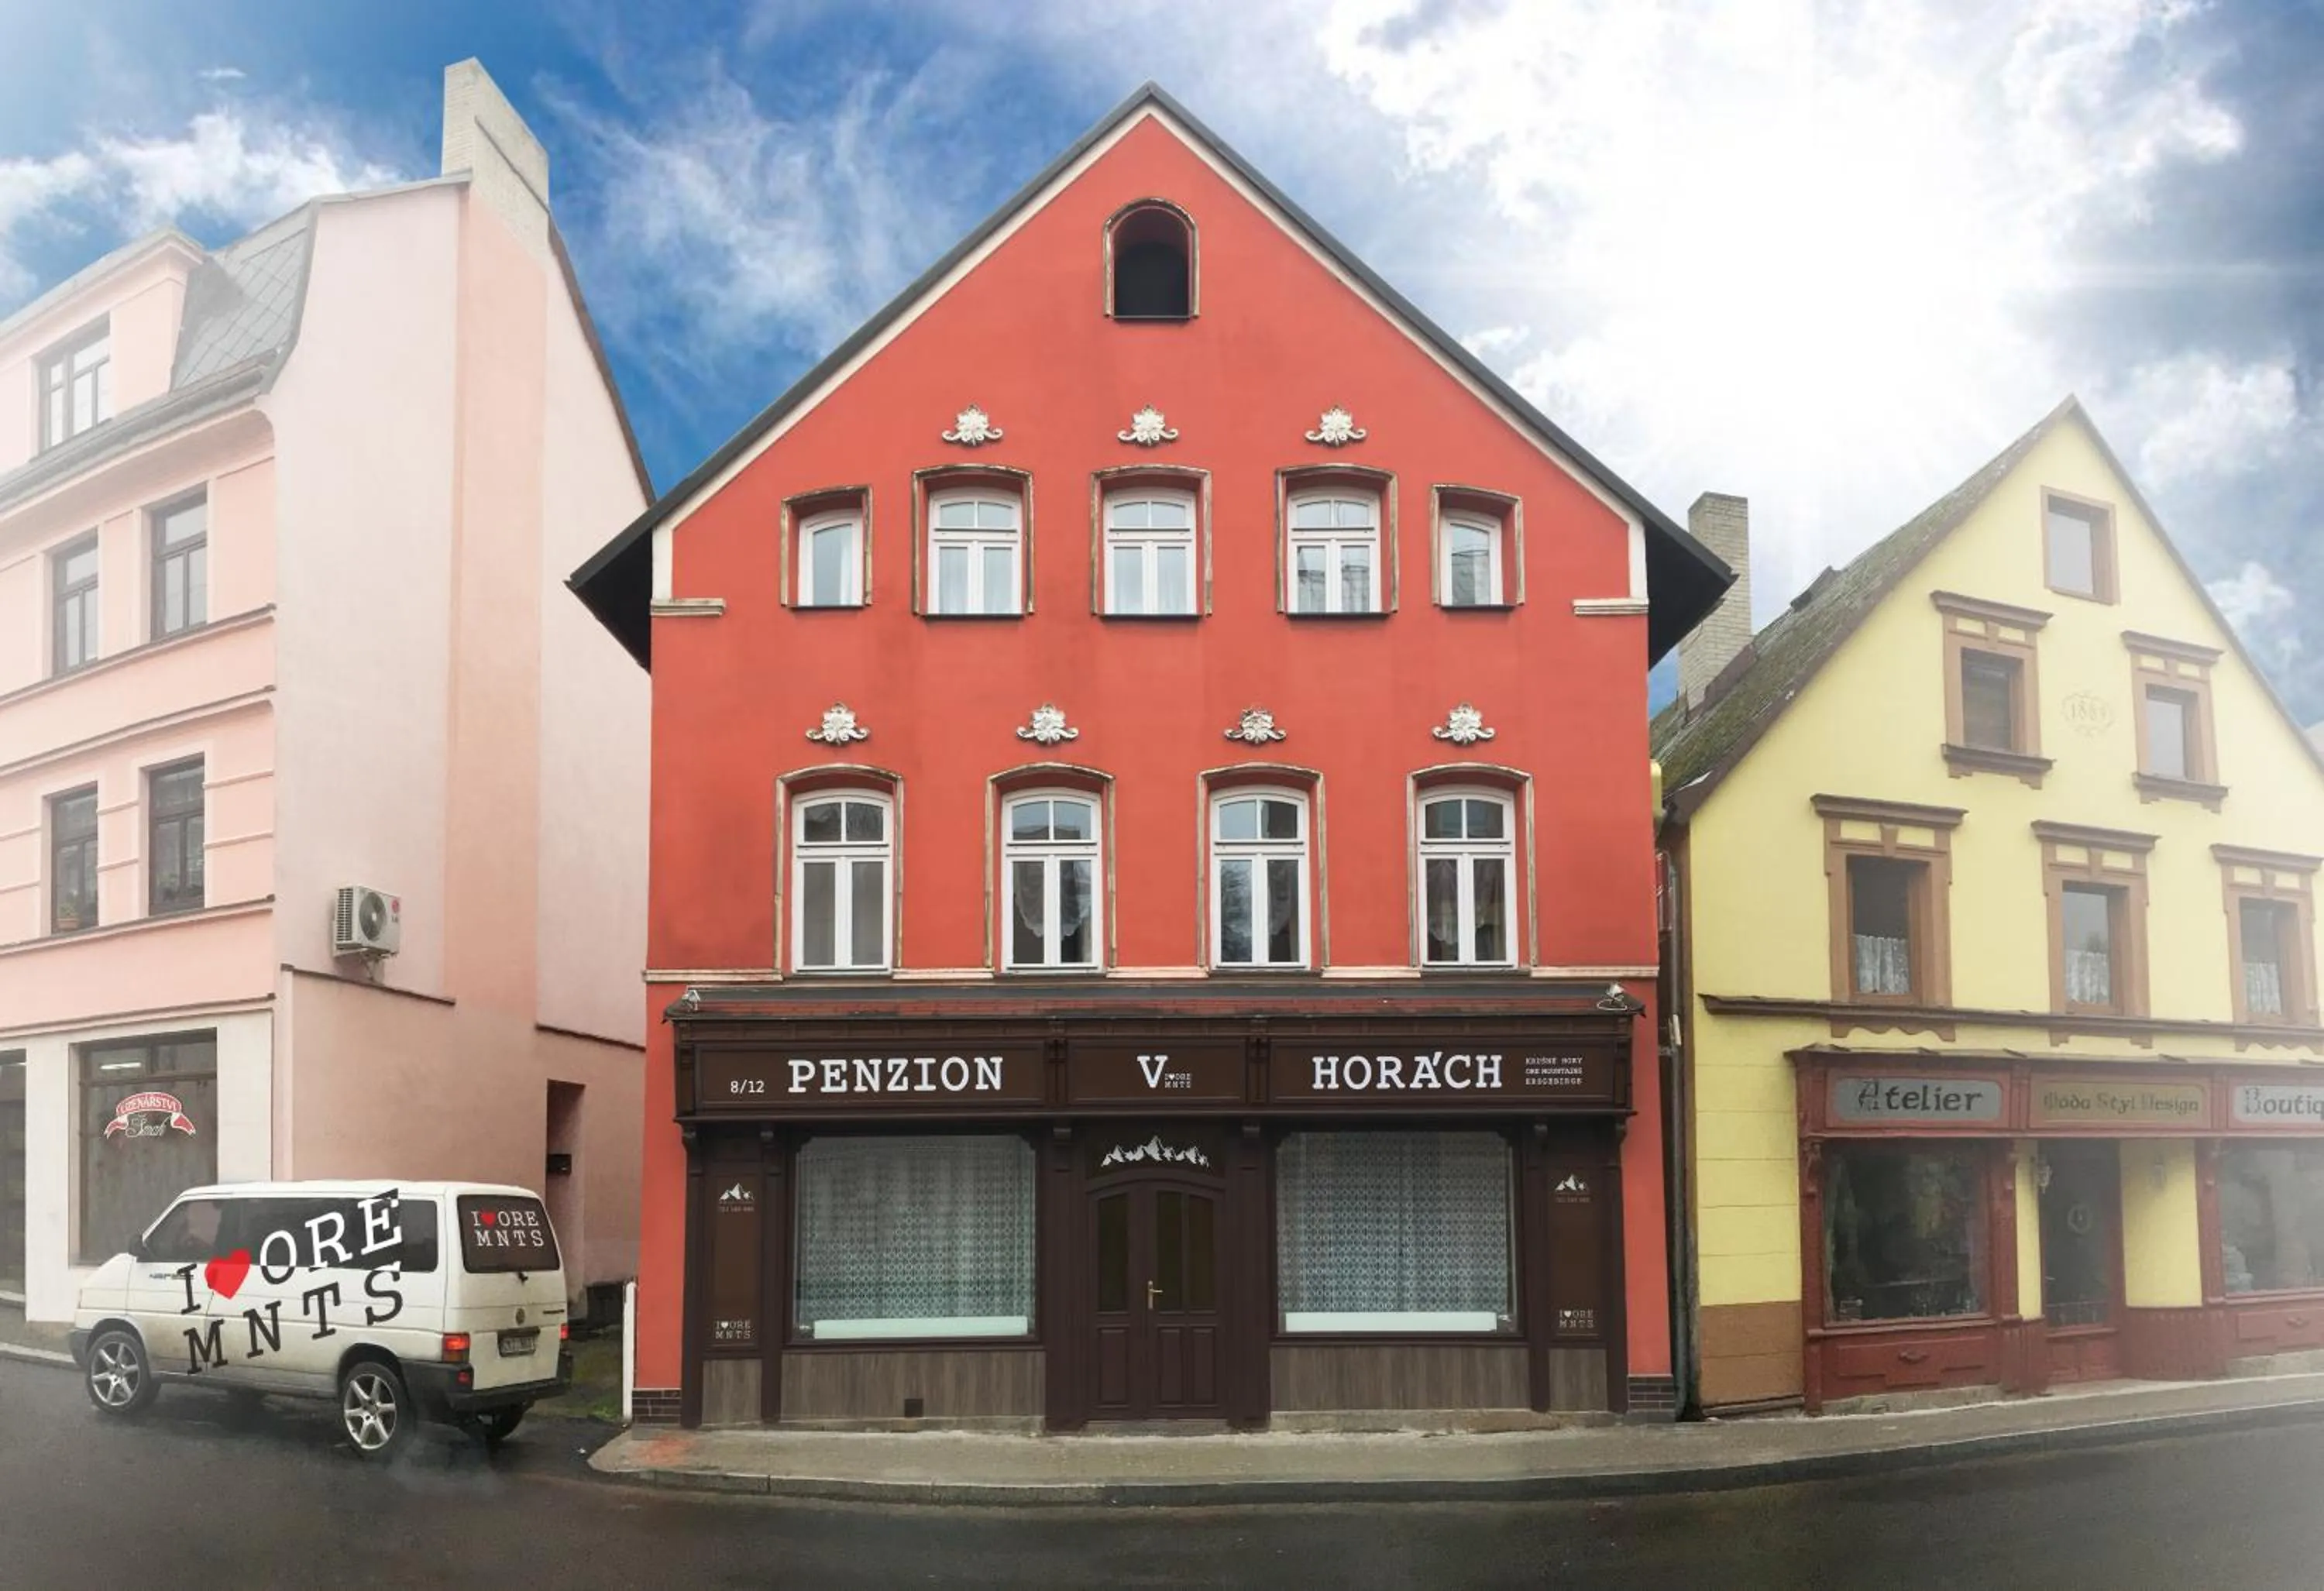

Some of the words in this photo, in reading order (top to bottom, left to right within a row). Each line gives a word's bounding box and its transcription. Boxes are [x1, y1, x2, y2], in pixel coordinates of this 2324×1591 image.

[731, 1080, 765, 1094] 8/12
[788, 1056, 1003, 1093] PENZION
[1137, 1055, 1168, 1088] V
[1312, 1051, 1502, 1089] HORÁCH
[1858, 1081, 1983, 1111] Atelier
[260, 1188, 403, 1285] ORE
[498, 1211, 539, 1226] ORE
[475, 1230, 545, 1246] MNTS
[183, 1261, 403, 1375] MNTS
